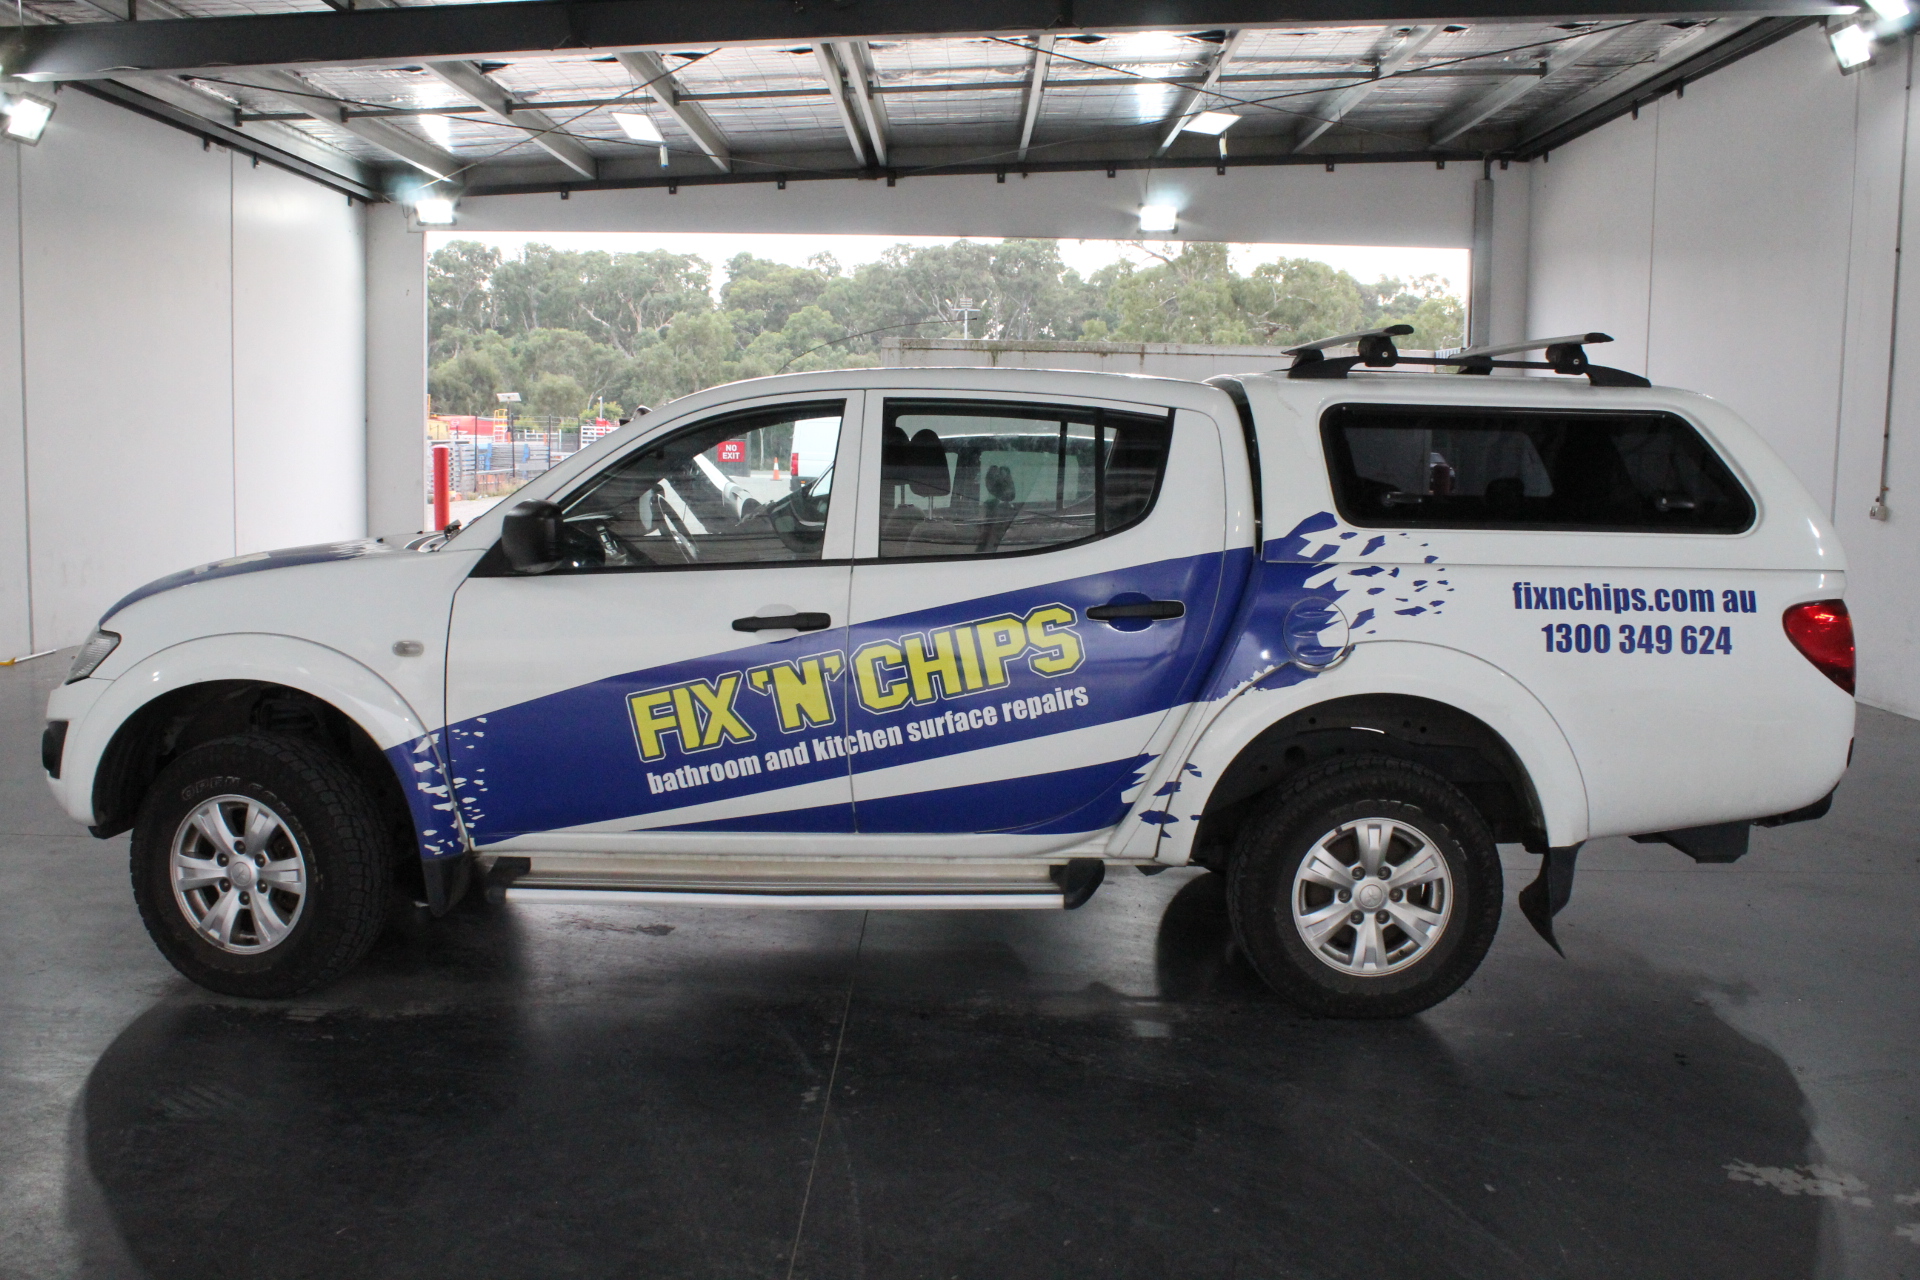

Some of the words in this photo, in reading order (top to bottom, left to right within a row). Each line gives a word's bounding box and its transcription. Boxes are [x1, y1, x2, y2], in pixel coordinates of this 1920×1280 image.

[722, 452, 741, 460] EXIT
[725, 444, 738, 452] NO
[1512, 582, 1716, 614] fixnchips.com
[1722, 589, 1757, 613] au
[1541, 623, 1611, 653] 1300
[1618, 624, 1673, 654] 349
[1680, 625, 1733, 655] 624
[626, 670, 756, 762] FIX
[851, 603, 1085, 714] CHIPS
[647, 755, 762, 794] bathroom
[765, 741, 810, 771] and
[812, 724, 903, 761] kitchen
[906, 706, 998, 742] surface
[1002, 686, 1089, 722] repairs
[181, 776, 241, 802] OPEN
